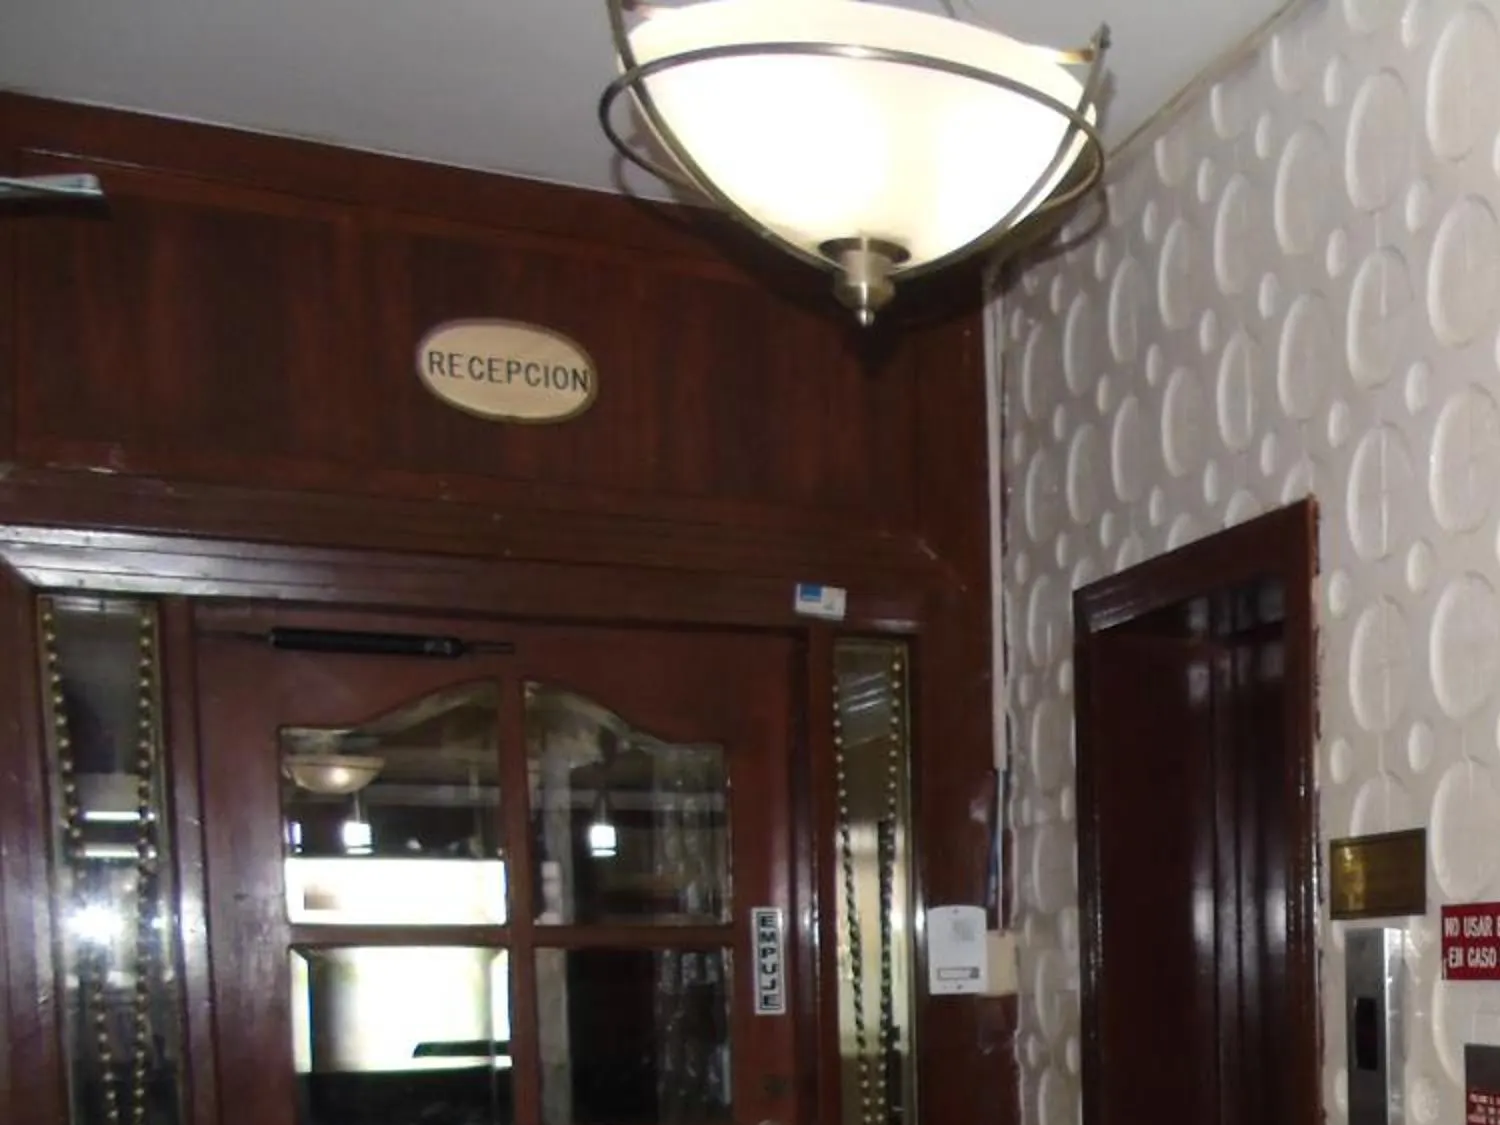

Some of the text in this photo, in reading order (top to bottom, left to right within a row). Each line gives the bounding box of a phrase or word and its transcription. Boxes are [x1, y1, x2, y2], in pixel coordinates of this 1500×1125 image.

[428, 351, 589, 393] RECEPCION
[1444, 916, 1461, 937] NO
[1463, 915, 1493, 938] USAR
[760, 915, 778, 1006] EMPUJE
[1448, 947, 1464, 967] EN
[1467, 947, 1497, 968] CASO
